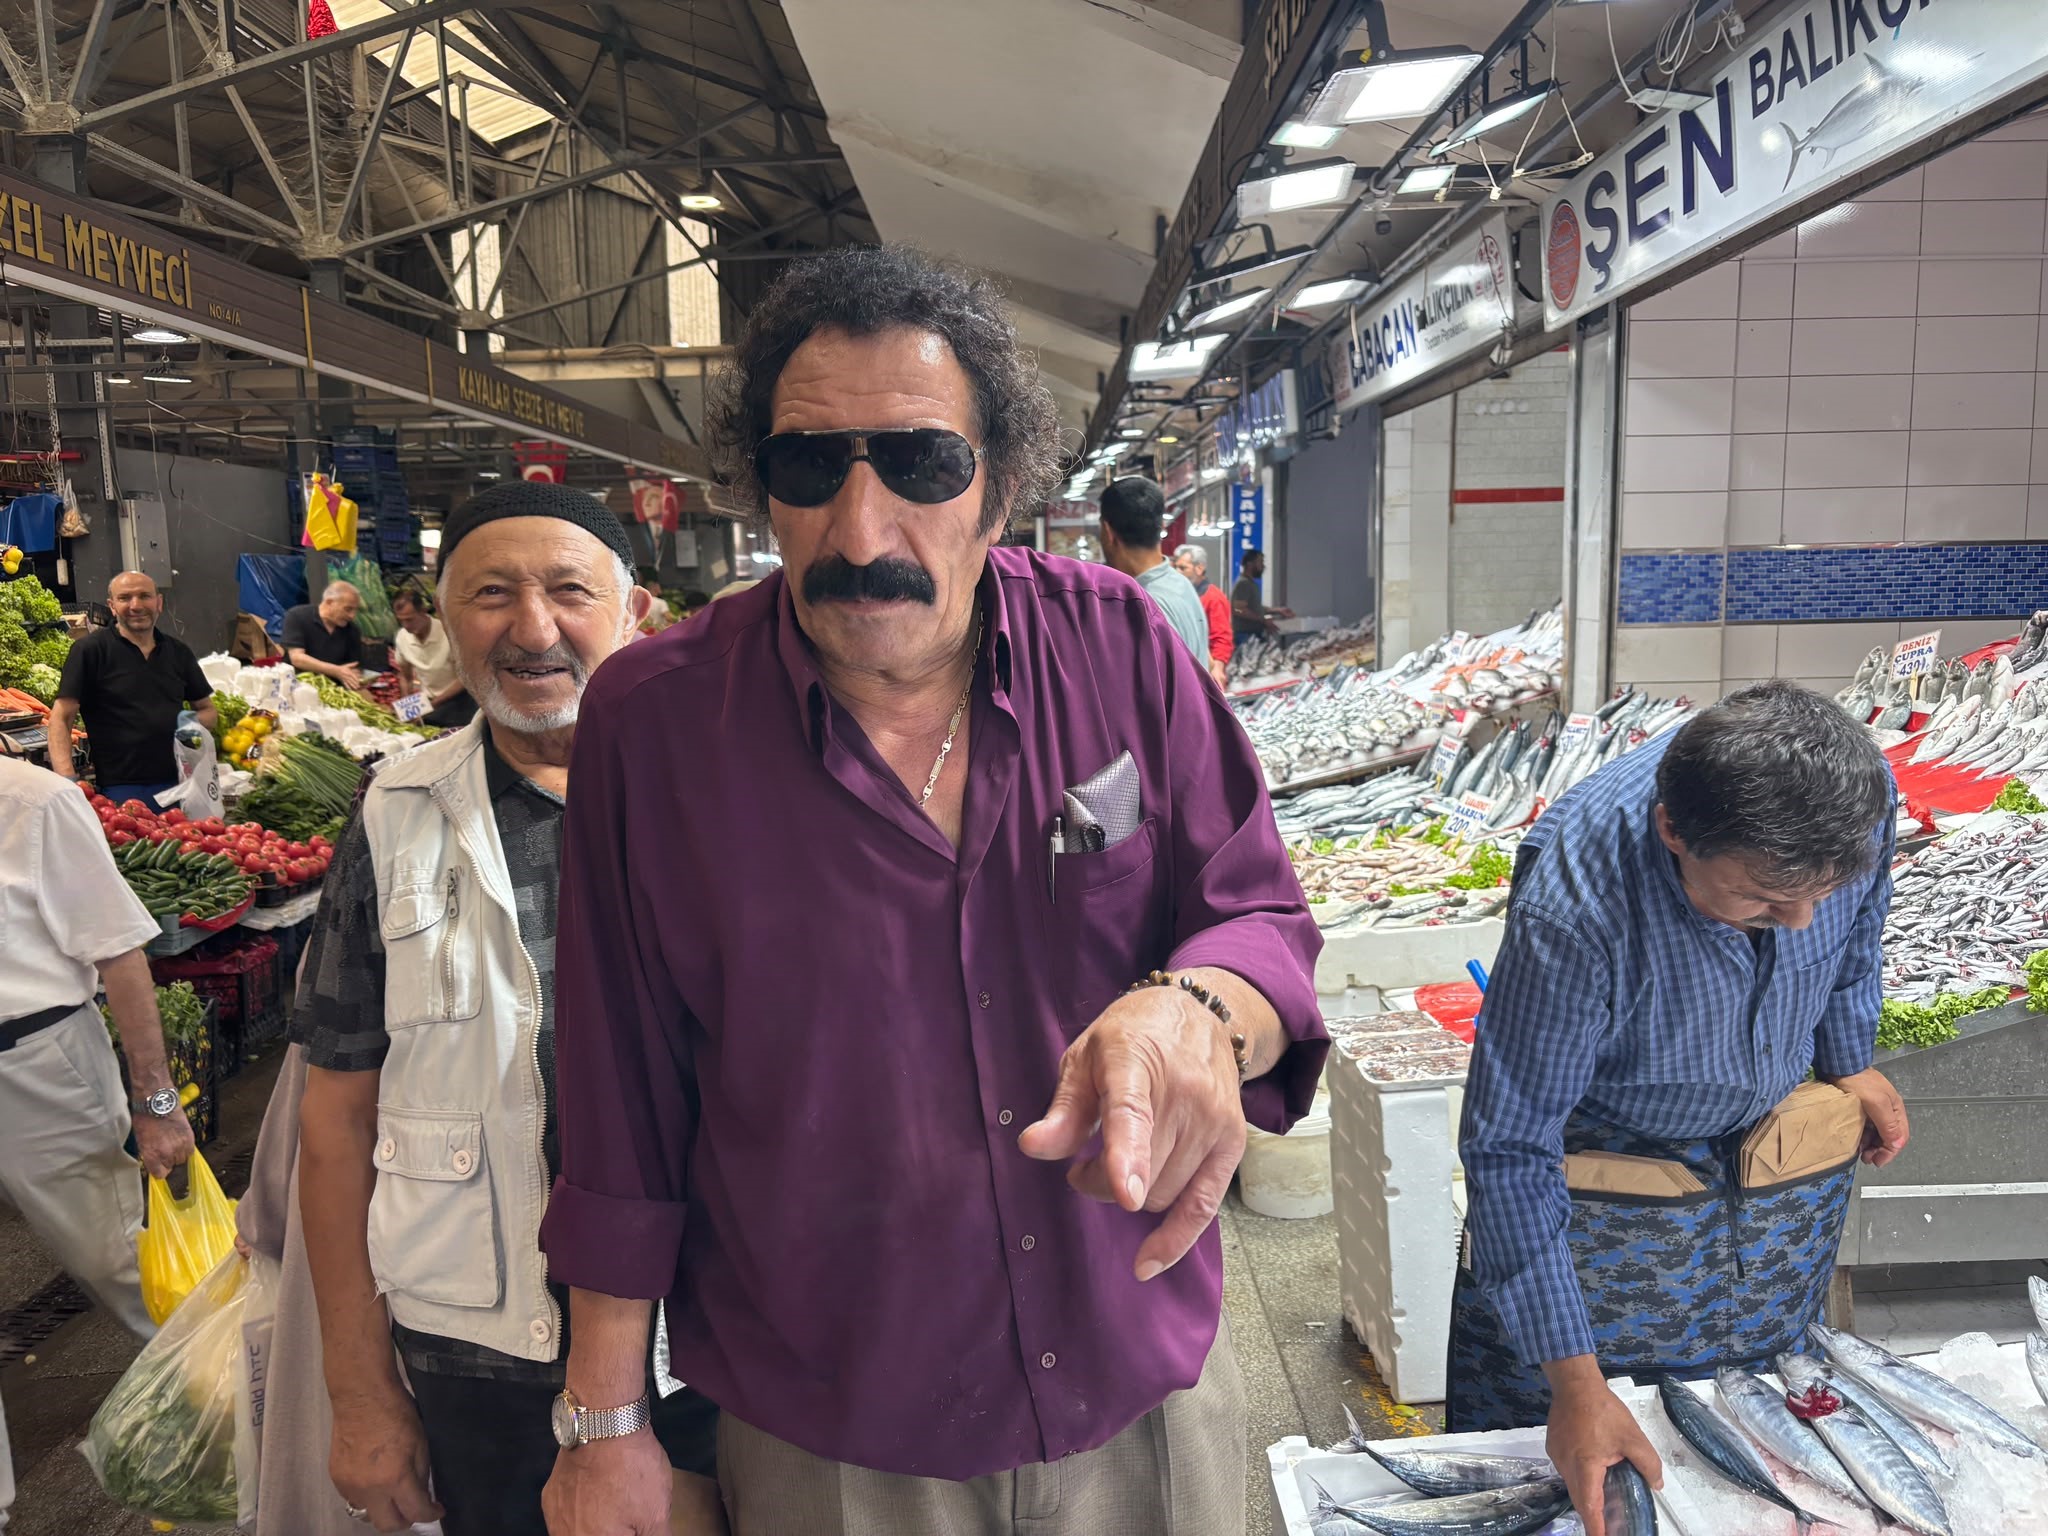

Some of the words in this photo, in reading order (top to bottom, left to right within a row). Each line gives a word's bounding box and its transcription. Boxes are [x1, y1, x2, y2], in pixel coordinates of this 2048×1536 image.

[1584, 76, 1735, 293] ŞEN
[64, 212, 193, 310] MEYVECİ
[1415, 283, 1474, 334] LIKÇILIK
[459, 366, 510, 413] KAYALAR
[1902, 636, 1932, 652] DENİZ
[1447, 816, 1470, 833] 200
